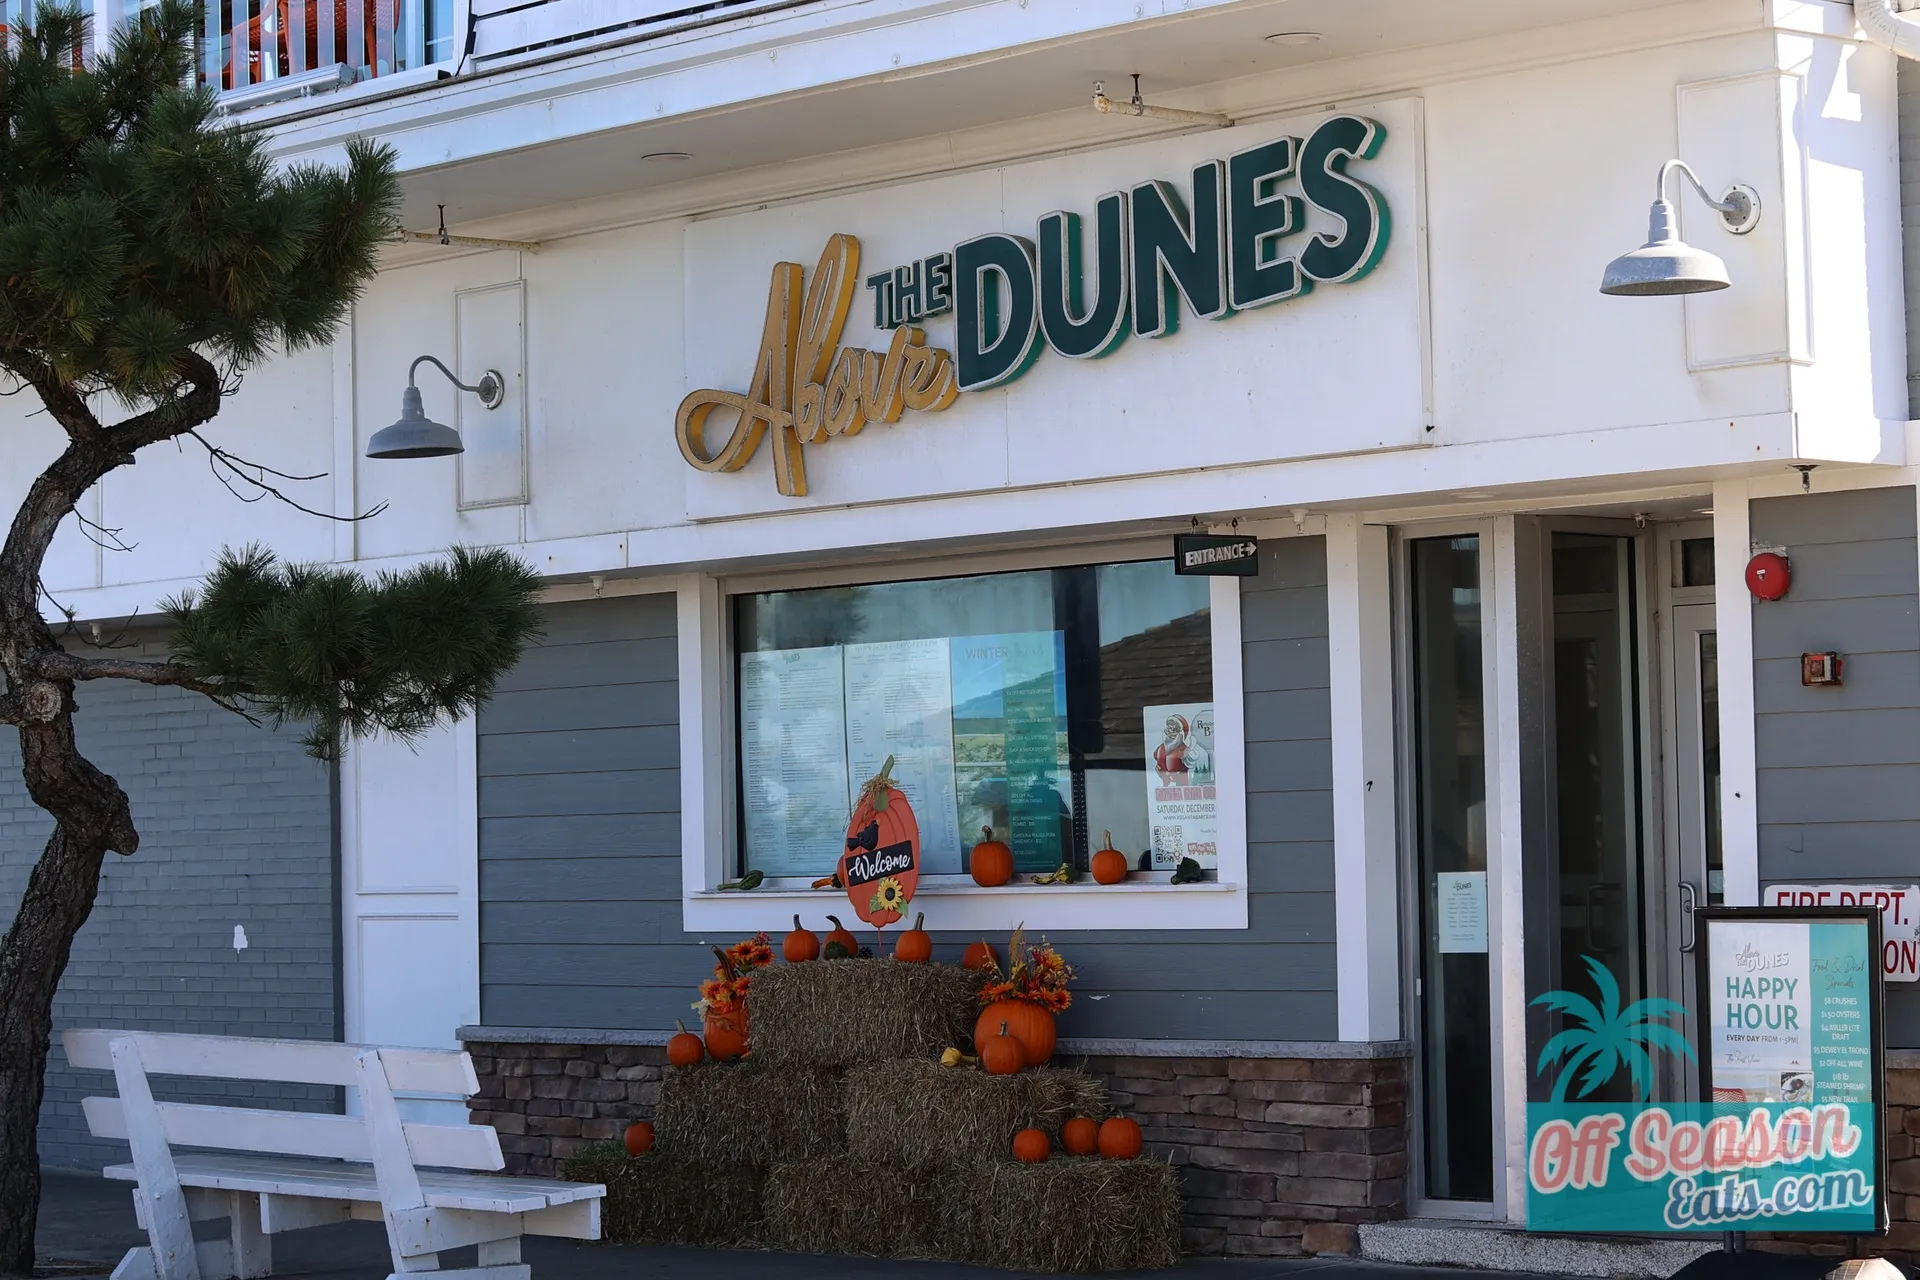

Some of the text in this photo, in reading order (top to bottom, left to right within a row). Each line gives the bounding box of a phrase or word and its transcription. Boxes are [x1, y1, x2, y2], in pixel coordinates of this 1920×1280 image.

[865, 114, 1390, 392] THE DUNES
[675, 232, 960, 497] Above
[1185, 543, 1245, 567] ENTRANCE
[965, 646, 1008, 660] WINTER
[1157, 803, 1216, 814] SATURDAY, DECEMBER
[848, 850, 911, 880] Welcome
[1746, 951, 1790, 973] DUNES
[1726, 976, 1798, 1000] HAPPY
[1832, 997, 1858, 1005] CRUSHES
[1727, 1003, 1799, 1030] HOUR
[1836, 1010, 1860, 1018] OYSTERS
[1726, 1034, 1745, 1042] EVERY
